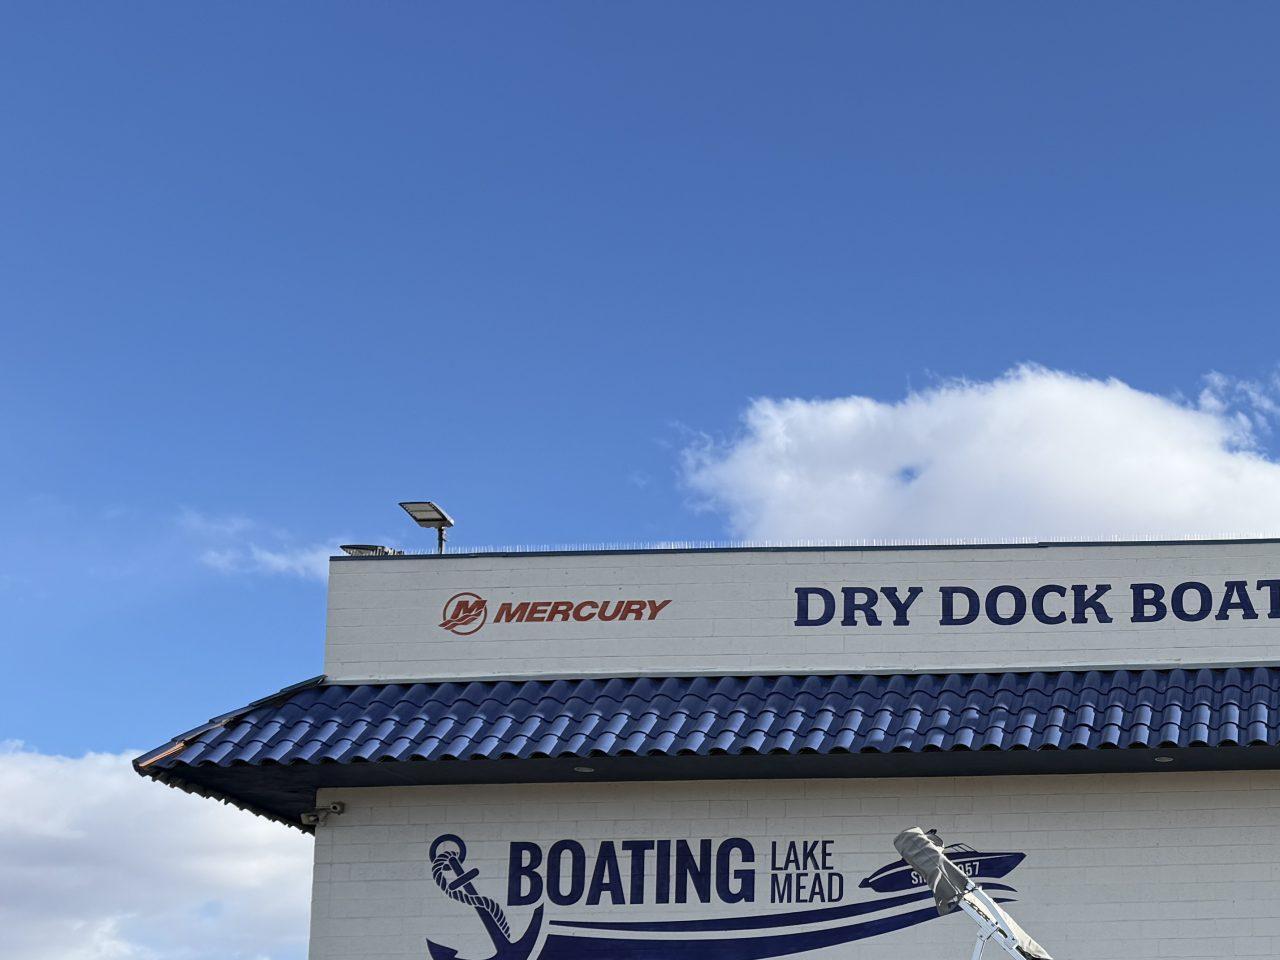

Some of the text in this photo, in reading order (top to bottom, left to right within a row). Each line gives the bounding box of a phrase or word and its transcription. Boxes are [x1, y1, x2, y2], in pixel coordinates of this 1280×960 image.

[493, 599, 673, 624] MERCURY
[794, 587, 923, 627] DRY
[938, 583, 1113, 626] DOCK
[770, 839, 835, 871] LAKE
[507, 837, 756, 906] BOATING
[770, 872, 844, 904] MEAD
